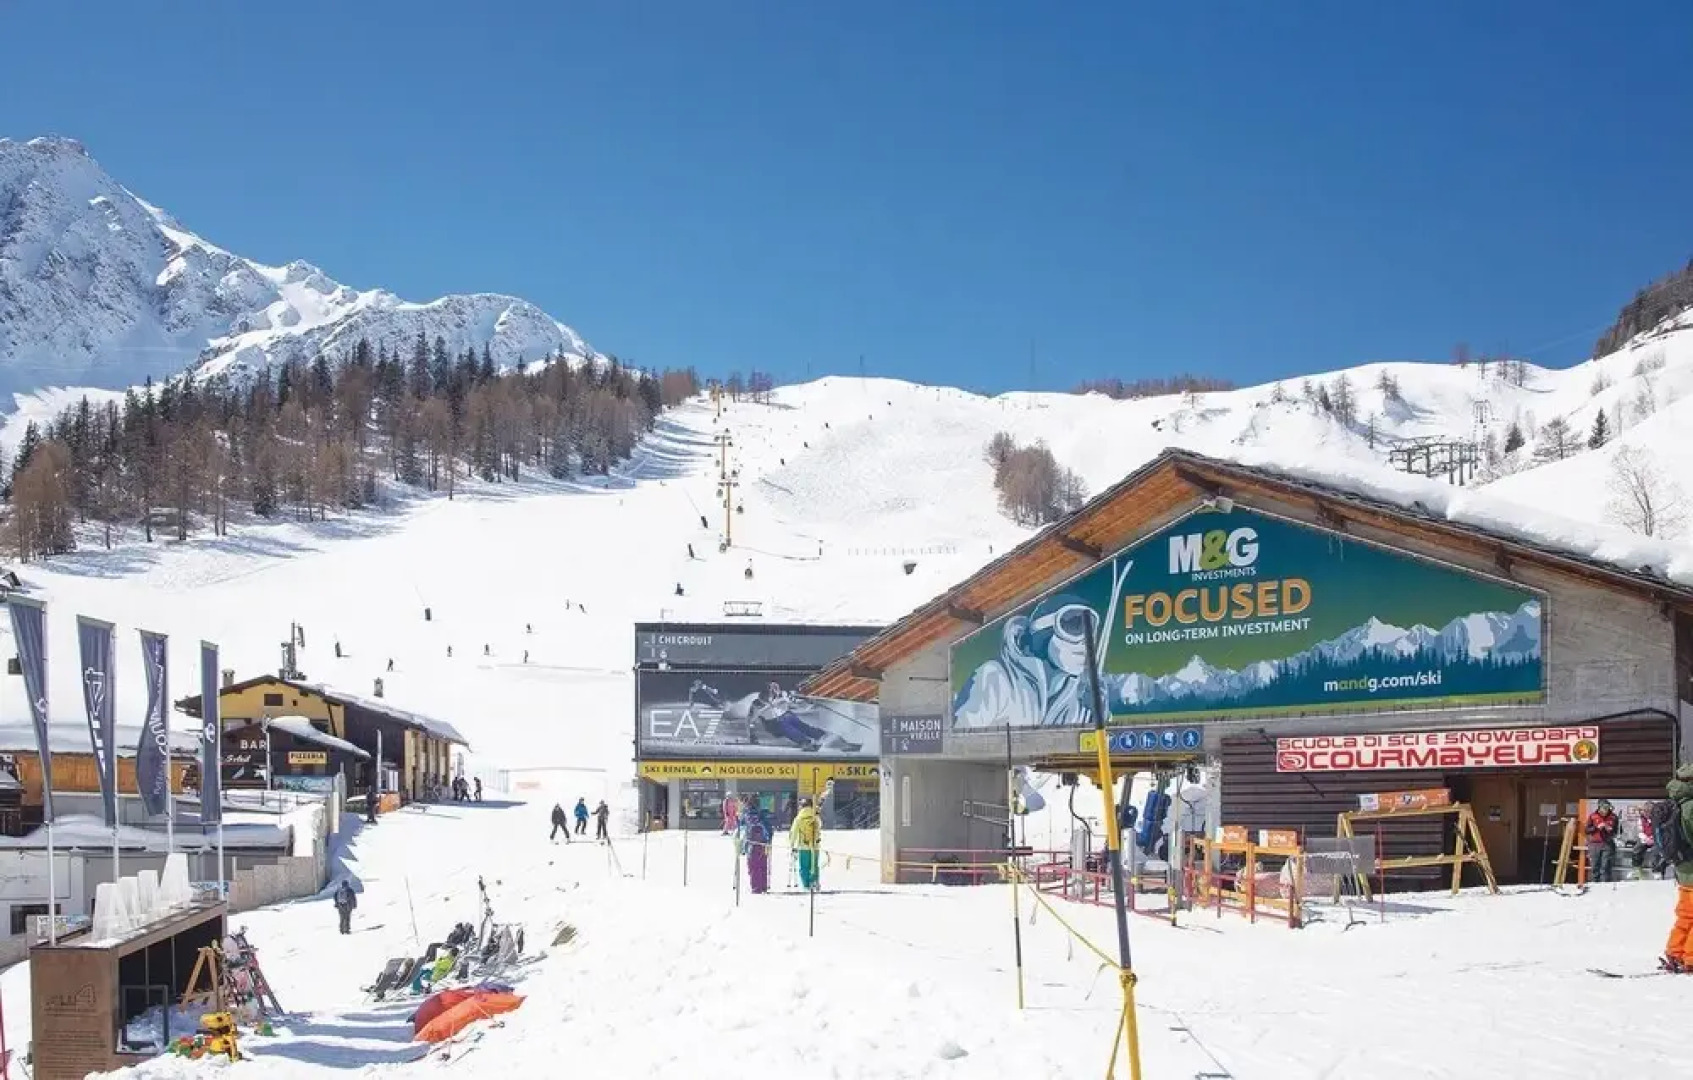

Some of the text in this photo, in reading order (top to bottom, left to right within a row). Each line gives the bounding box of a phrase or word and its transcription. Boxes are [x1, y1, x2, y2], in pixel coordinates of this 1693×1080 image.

[1169, 527, 1259, 575] M&G
[1191, 566, 1257, 582] INVESTMENTS
[1124, 578, 1312, 629] FOCUSED
[1125, 617, 1312, 645] ON LONG-TERM INVESTMENT
[1323, 669, 1442, 693] mandg.com/ski
[650, 709, 724, 737] EA7
[900, 719, 941, 732] MAISON
[241, 739, 267, 749] BAR
[1363, 734, 1382, 748] DI
[1387, 733, 1420, 747] SCI
[1426, 733, 1438, 746] E
[645, 765, 697, 774] SKI RENTAL
[719, 765, 795, 775] NOLEGGIO SCI
[846, 766, 866, 776] SKI
